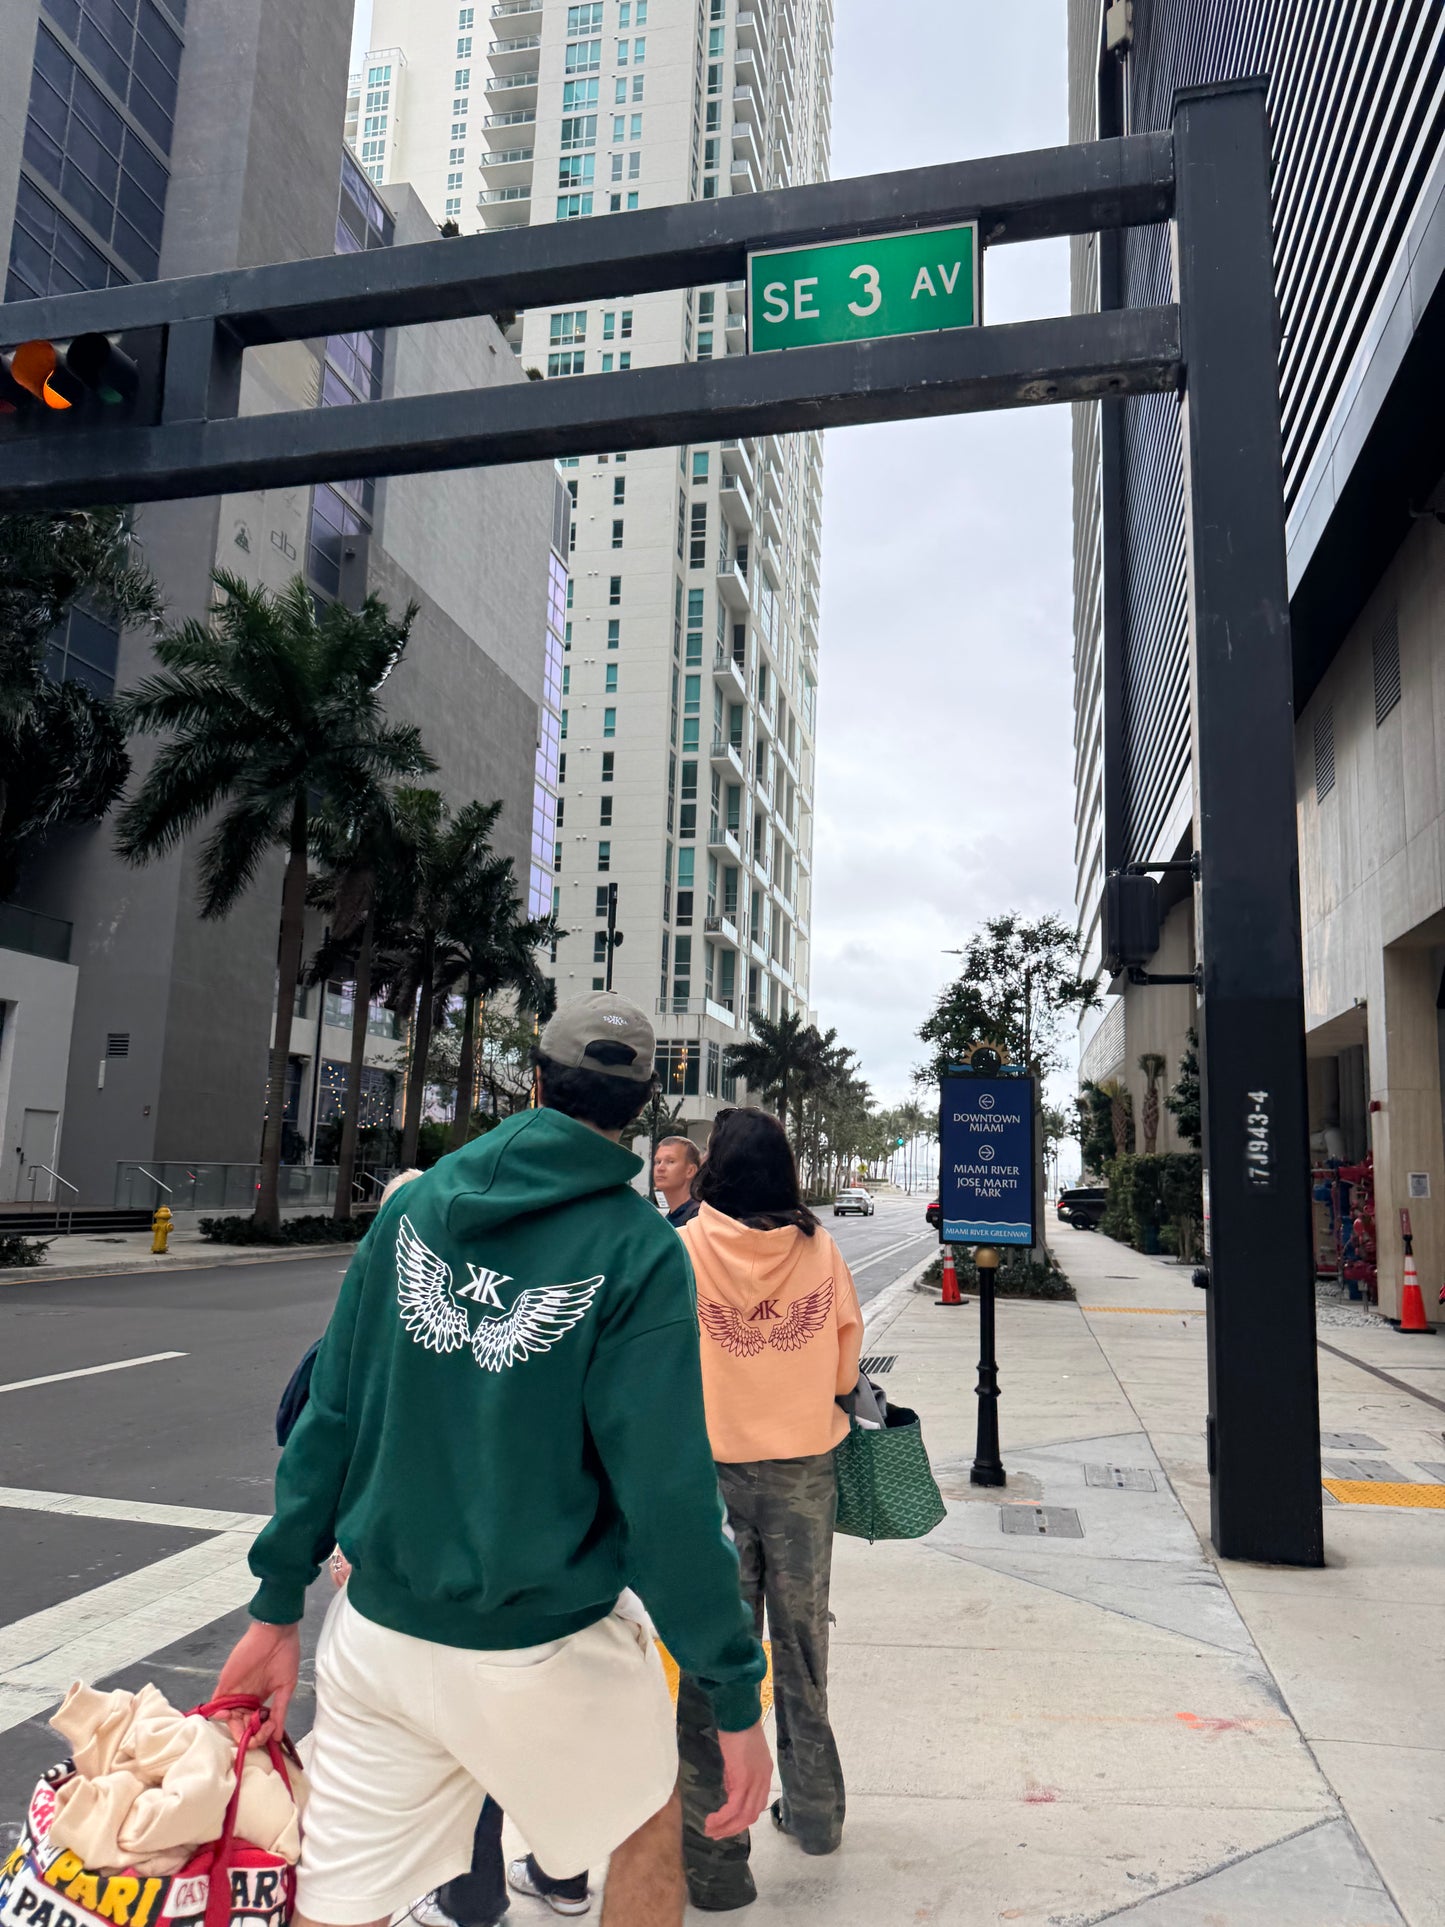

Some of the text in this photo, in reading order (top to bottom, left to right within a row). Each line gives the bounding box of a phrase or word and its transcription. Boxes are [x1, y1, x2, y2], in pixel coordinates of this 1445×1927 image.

[762, 261, 962, 324] SE 3 AV
[953, 1113, 1021, 1124] DOWNTOWN
[969, 1123, 1004, 1133] MIAMI
[1247, 1091, 1270, 1185] 7J943-4
[953, 1164, 1020, 1175] MIAMI RIVER
[957, 1177, 1018, 1188] JOSE MARTI
[975, 1188, 1002, 1197] PARK
[990, 1230, 1029, 1238] GREENWAY
